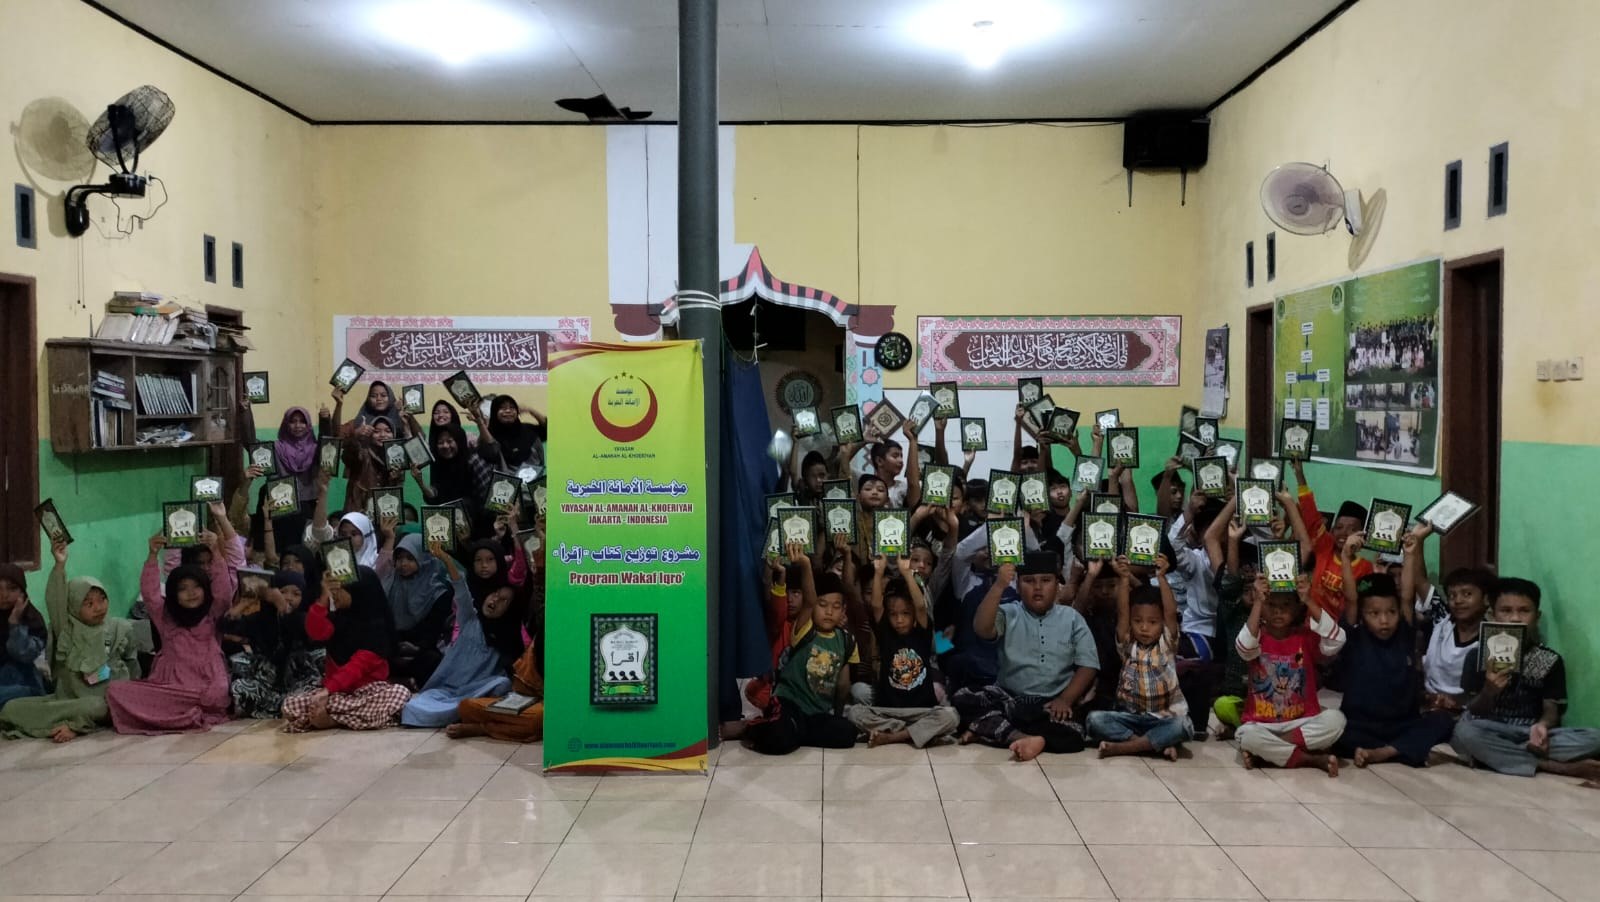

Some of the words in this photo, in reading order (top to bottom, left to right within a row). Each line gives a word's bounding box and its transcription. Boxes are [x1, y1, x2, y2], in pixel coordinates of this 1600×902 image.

[561, 503, 593, 512] YAYASAN
[594, 503, 639, 512] AL-AMANAH
[640, 503, 693, 512] AL-KHOERIYAH
[588, 515, 622, 524] JAKARTA
[627, 515, 668, 524] INDONESIA
[591, 545, 622, 561] كتاب
[624, 547, 659, 563] توزيع
[661, 546, 700, 563] مشروع
[569, 572, 619, 585] Program
[621, 571, 658, 584] Wakaf
